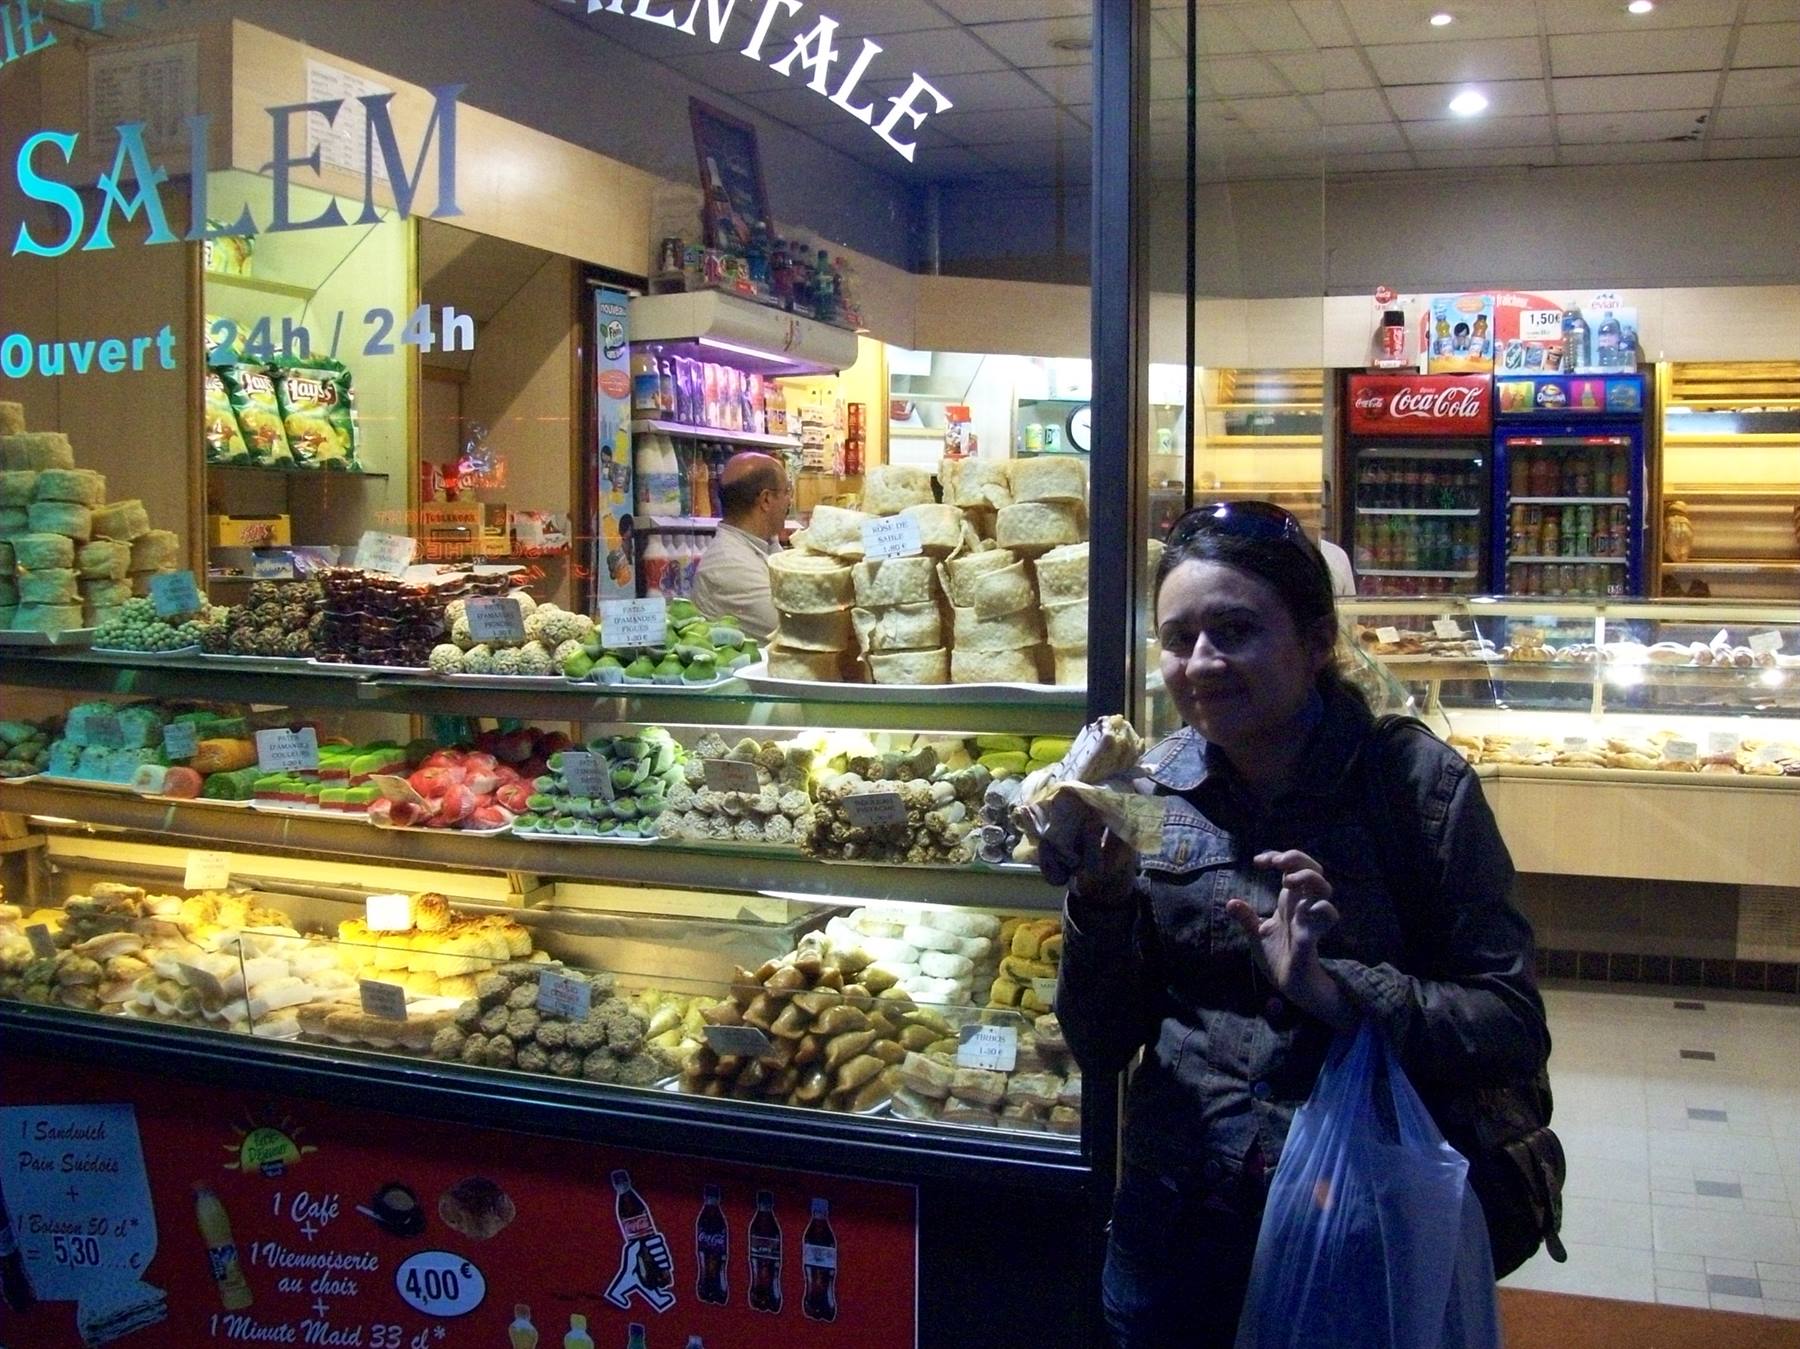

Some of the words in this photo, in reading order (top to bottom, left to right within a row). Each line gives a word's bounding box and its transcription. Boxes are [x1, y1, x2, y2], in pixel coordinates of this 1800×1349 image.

[12, 83, 469, 257] SALEM
[0, 325, 177, 379] Ouvert
[208, 316, 311, 367] 24h
[363, 304, 475, 356] 24h
[1389, 386, 1485, 419] Coca-Cola
[34, 1120, 107, 1141] Sandwich
[18, 1151, 55, 1173] Pain
[61, 1152, 119, 1173] Suédois
[272, 1193, 281, 1216] 1
[291, 1191, 341, 1226] Café
[28, 1213, 82, 1234] Boisson
[87, 1217, 109, 1236] 50
[250, 1242, 258, 1265] 1
[261, 1242, 380, 1272] Viennoiserie
[278, 1278, 304, 1293] au
[310, 1271, 359, 1297] choix
[209, 1314, 218, 1337] 1
[222, 1315, 297, 1344] Minute
[300, 1319, 364, 1347] Maid
[370, 1324, 403, 1349] 33
